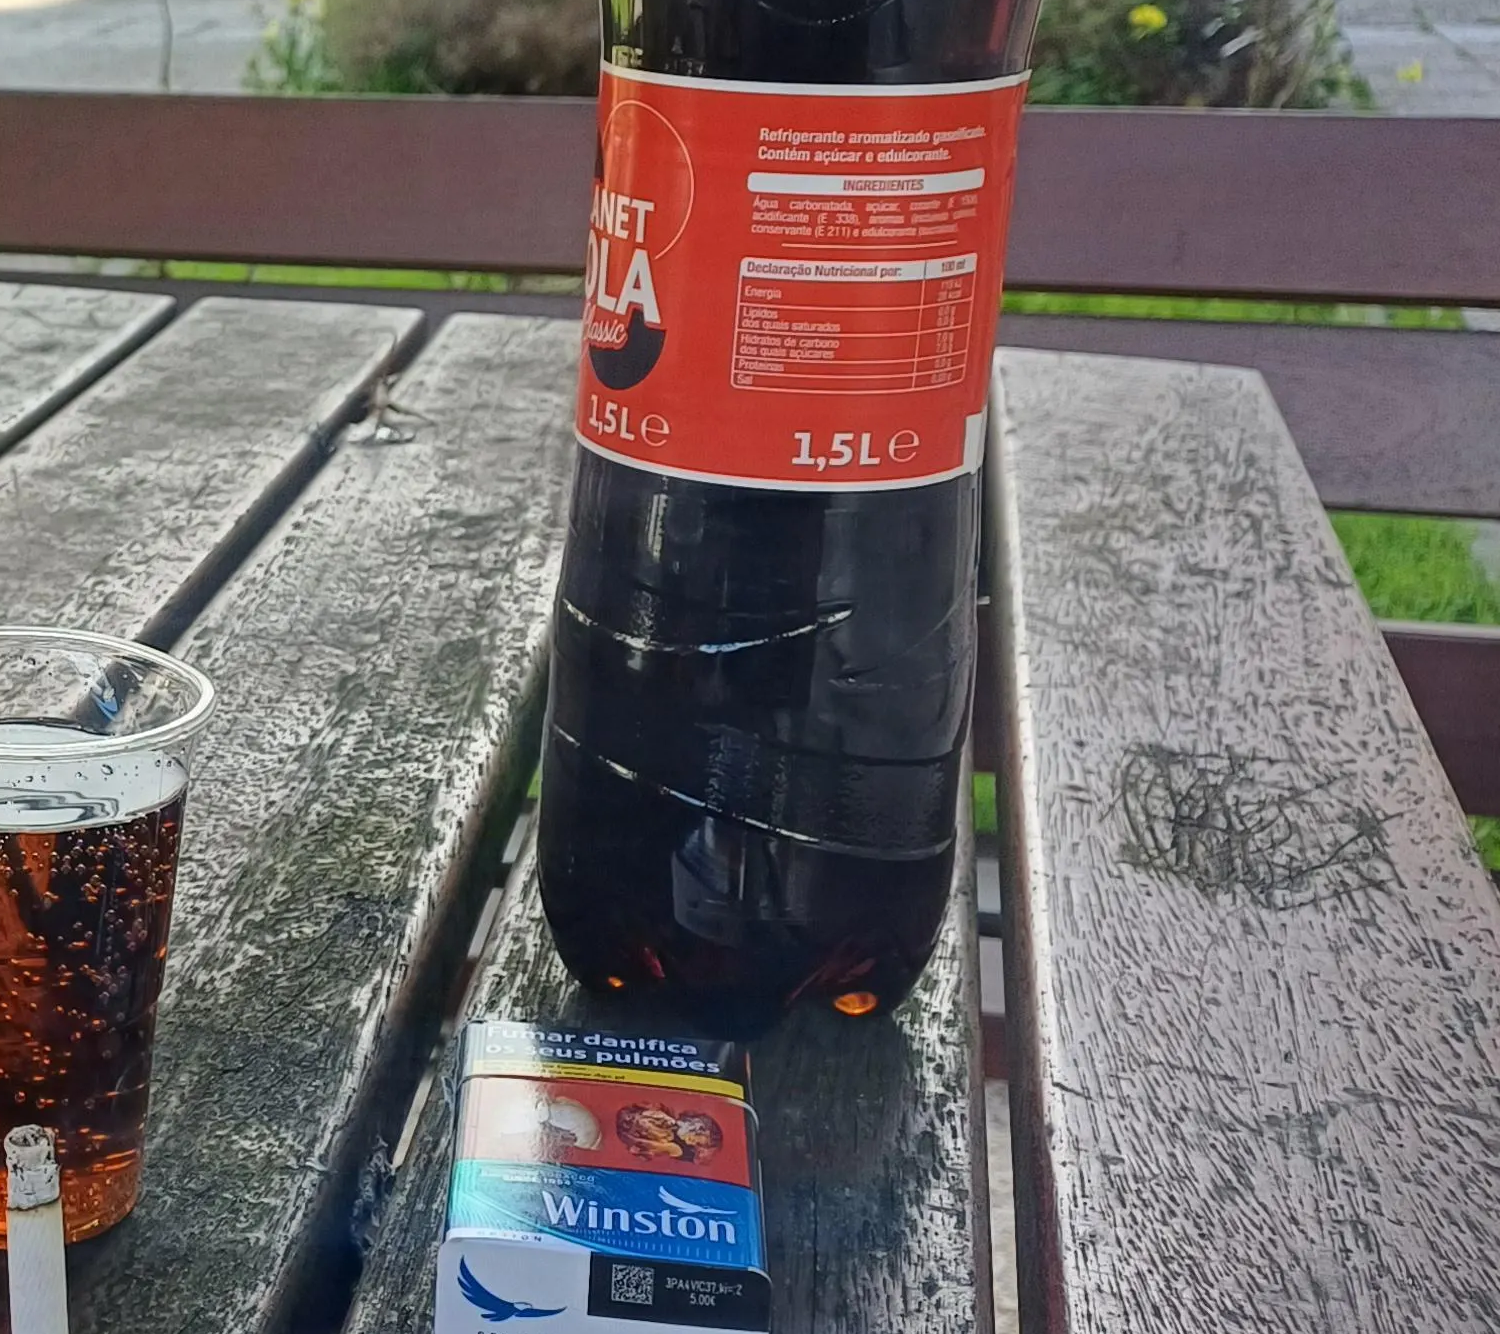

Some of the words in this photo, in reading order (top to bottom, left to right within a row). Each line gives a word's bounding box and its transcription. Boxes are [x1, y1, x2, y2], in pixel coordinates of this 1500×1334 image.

[760, 127, 845, 145] Refrigerante
[848, 130, 930, 144] aromatizado
[758, 146, 810, 161] Contém
[814, 148, 863, 165] açúcar
[865, 151, 874, 162] e
[843, 179, 924, 192] INGREDIENTES
[590, 184, 655, 243] ANET
[753, 195, 779, 210] Água
[751, 224, 812, 235] conservante
[852, 228, 859, 237] e
[584, 229, 661, 324] OLA
[747, 261, 812, 276] Declaração
[815, 264, 877, 278] Nutricional
[880, 267, 902, 279] por:
[583, 302, 627, 343] lassic
[791, 432, 881, 472] 1,5L
[488, 1026, 576, 1044] Fumar
[584, 1034, 698, 1055] danifica
[486, 1044, 514, 1055] os
[525, 1045, 587, 1060] seus
[596, 1050, 721, 1073] pulmões
[541, 1190, 737, 1244] Winston
